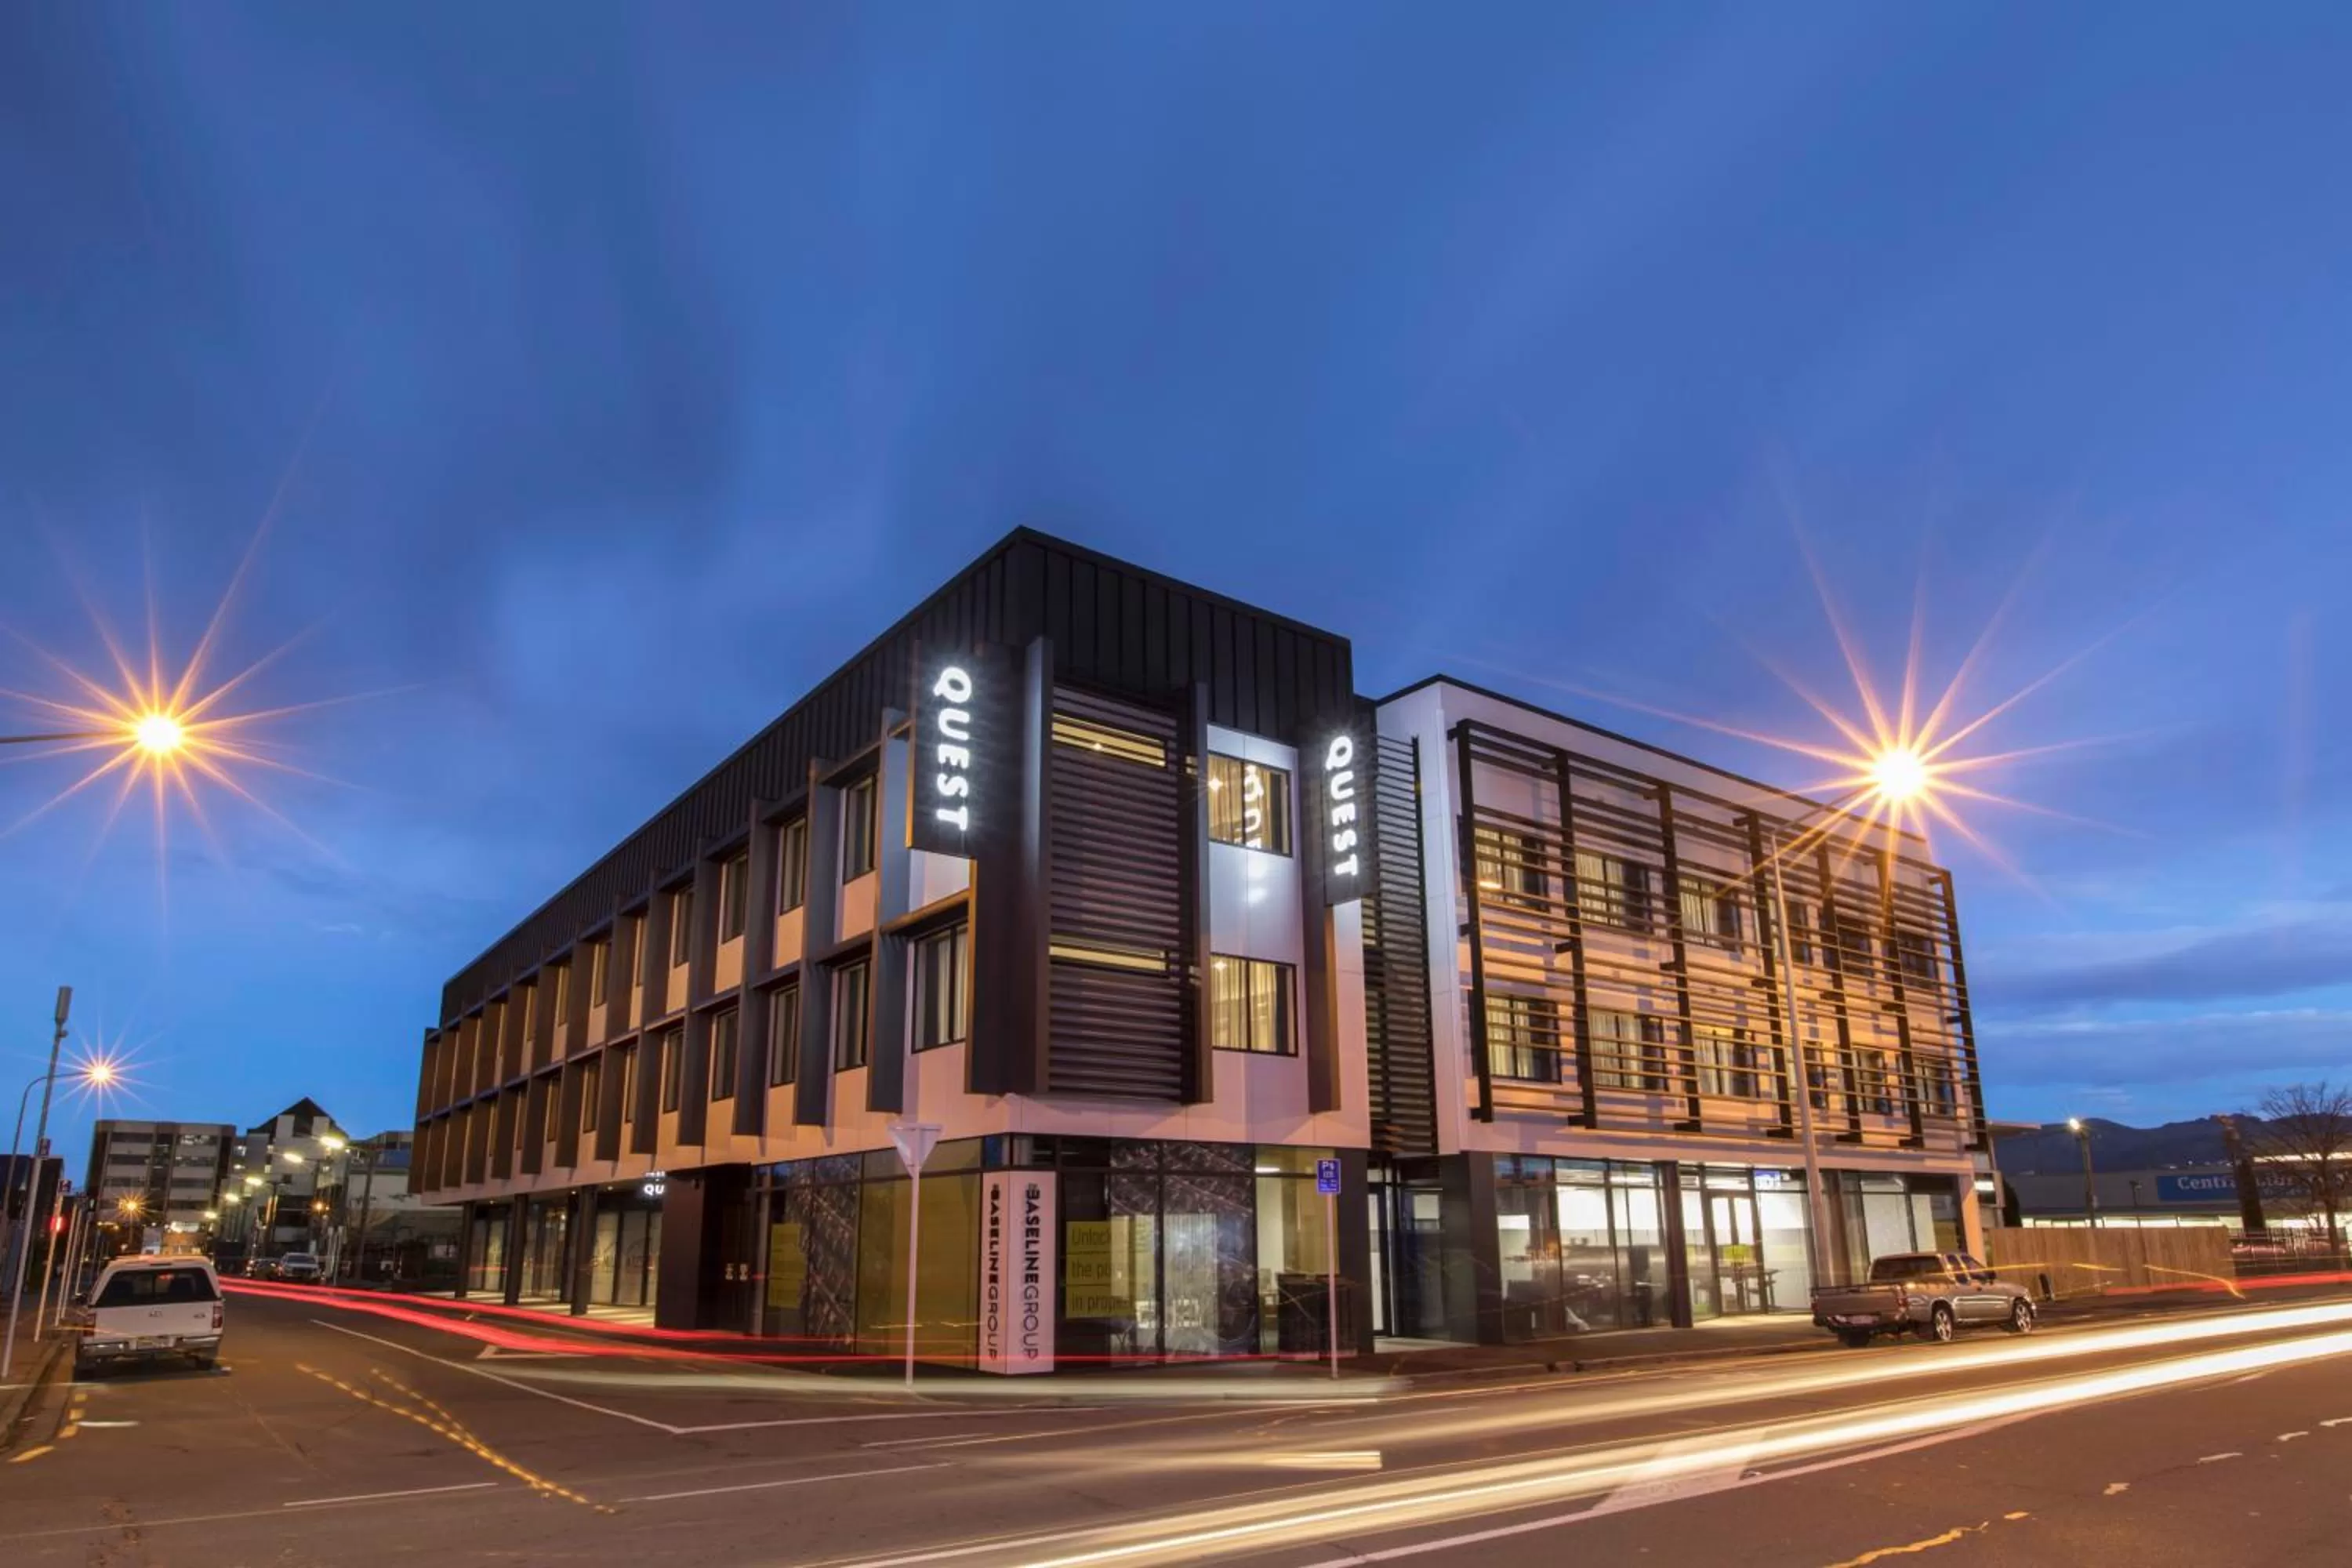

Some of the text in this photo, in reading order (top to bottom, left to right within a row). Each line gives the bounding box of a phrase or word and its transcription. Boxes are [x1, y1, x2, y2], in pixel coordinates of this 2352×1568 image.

[933, 666, 972, 832] QUEST
[1325, 735, 1358, 876] QUEST
[2177, 1176, 2237, 1190] Centra
